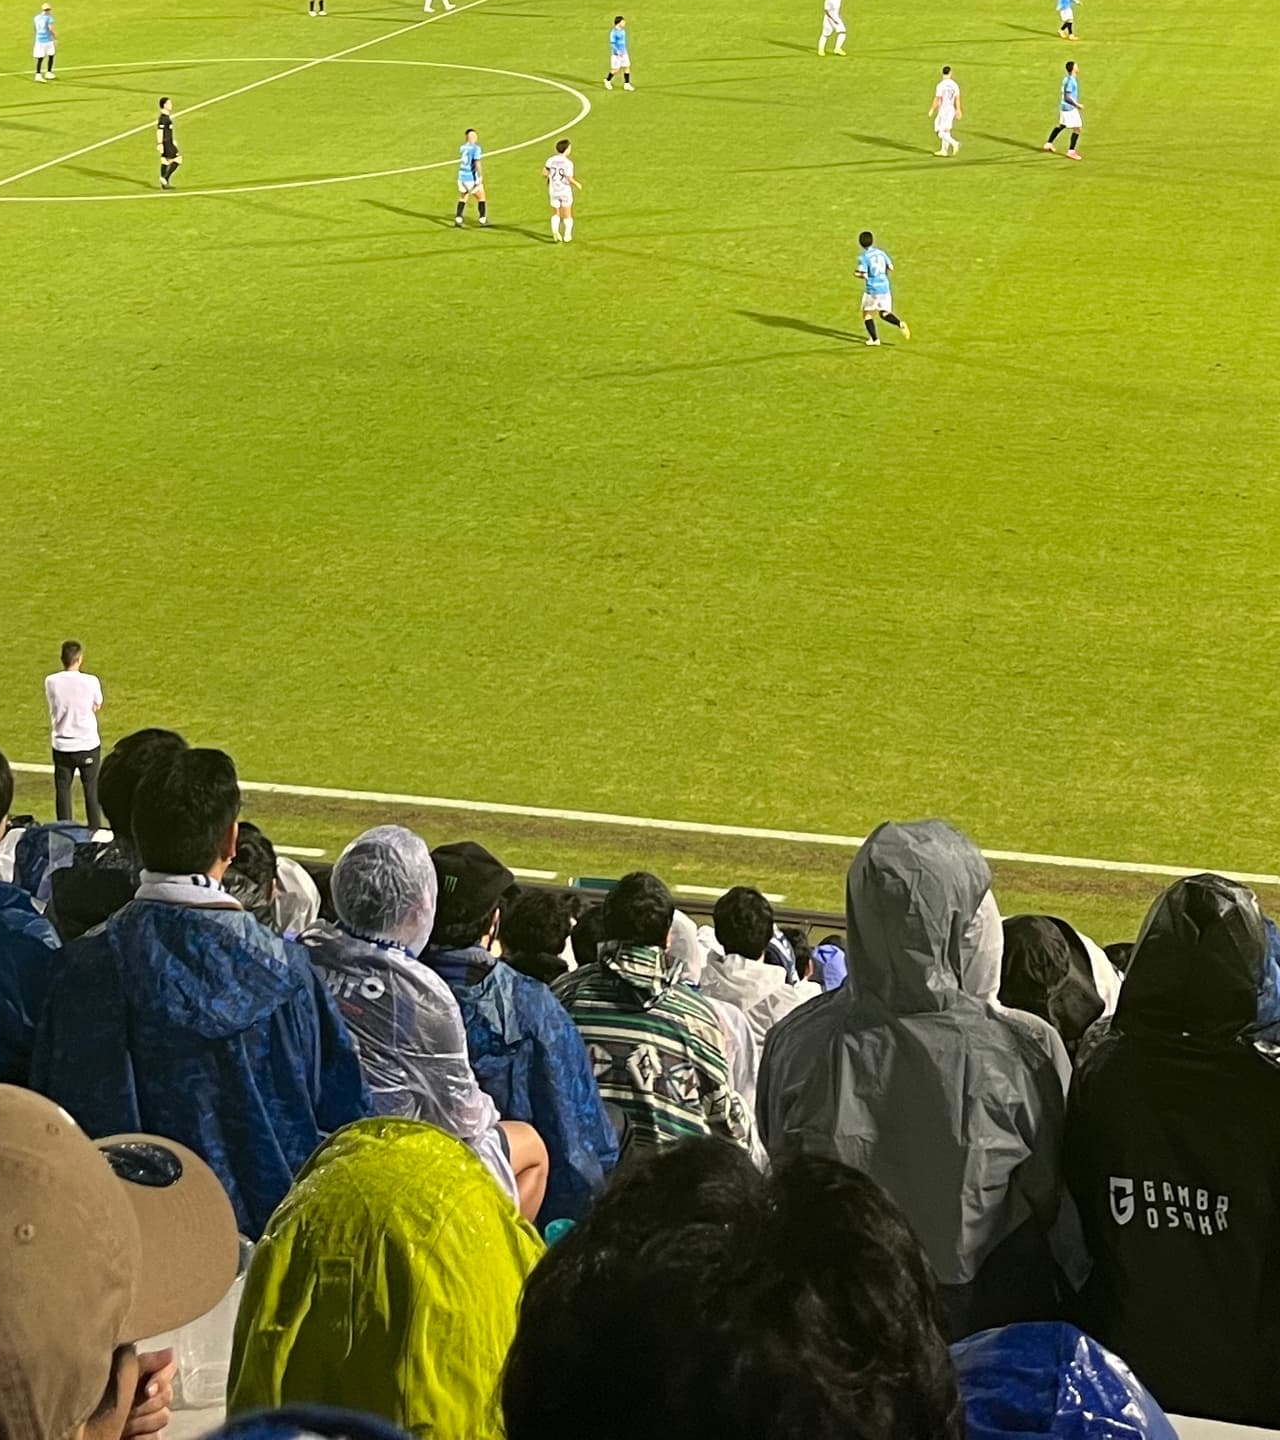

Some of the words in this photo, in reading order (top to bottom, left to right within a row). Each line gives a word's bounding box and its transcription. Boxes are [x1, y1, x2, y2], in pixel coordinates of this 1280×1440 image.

[552, 167, 565, 180] 29
[1143, 1180, 1229, 1213] GAMBA
[1146, 1206, 1228, 1236] OSAKA
